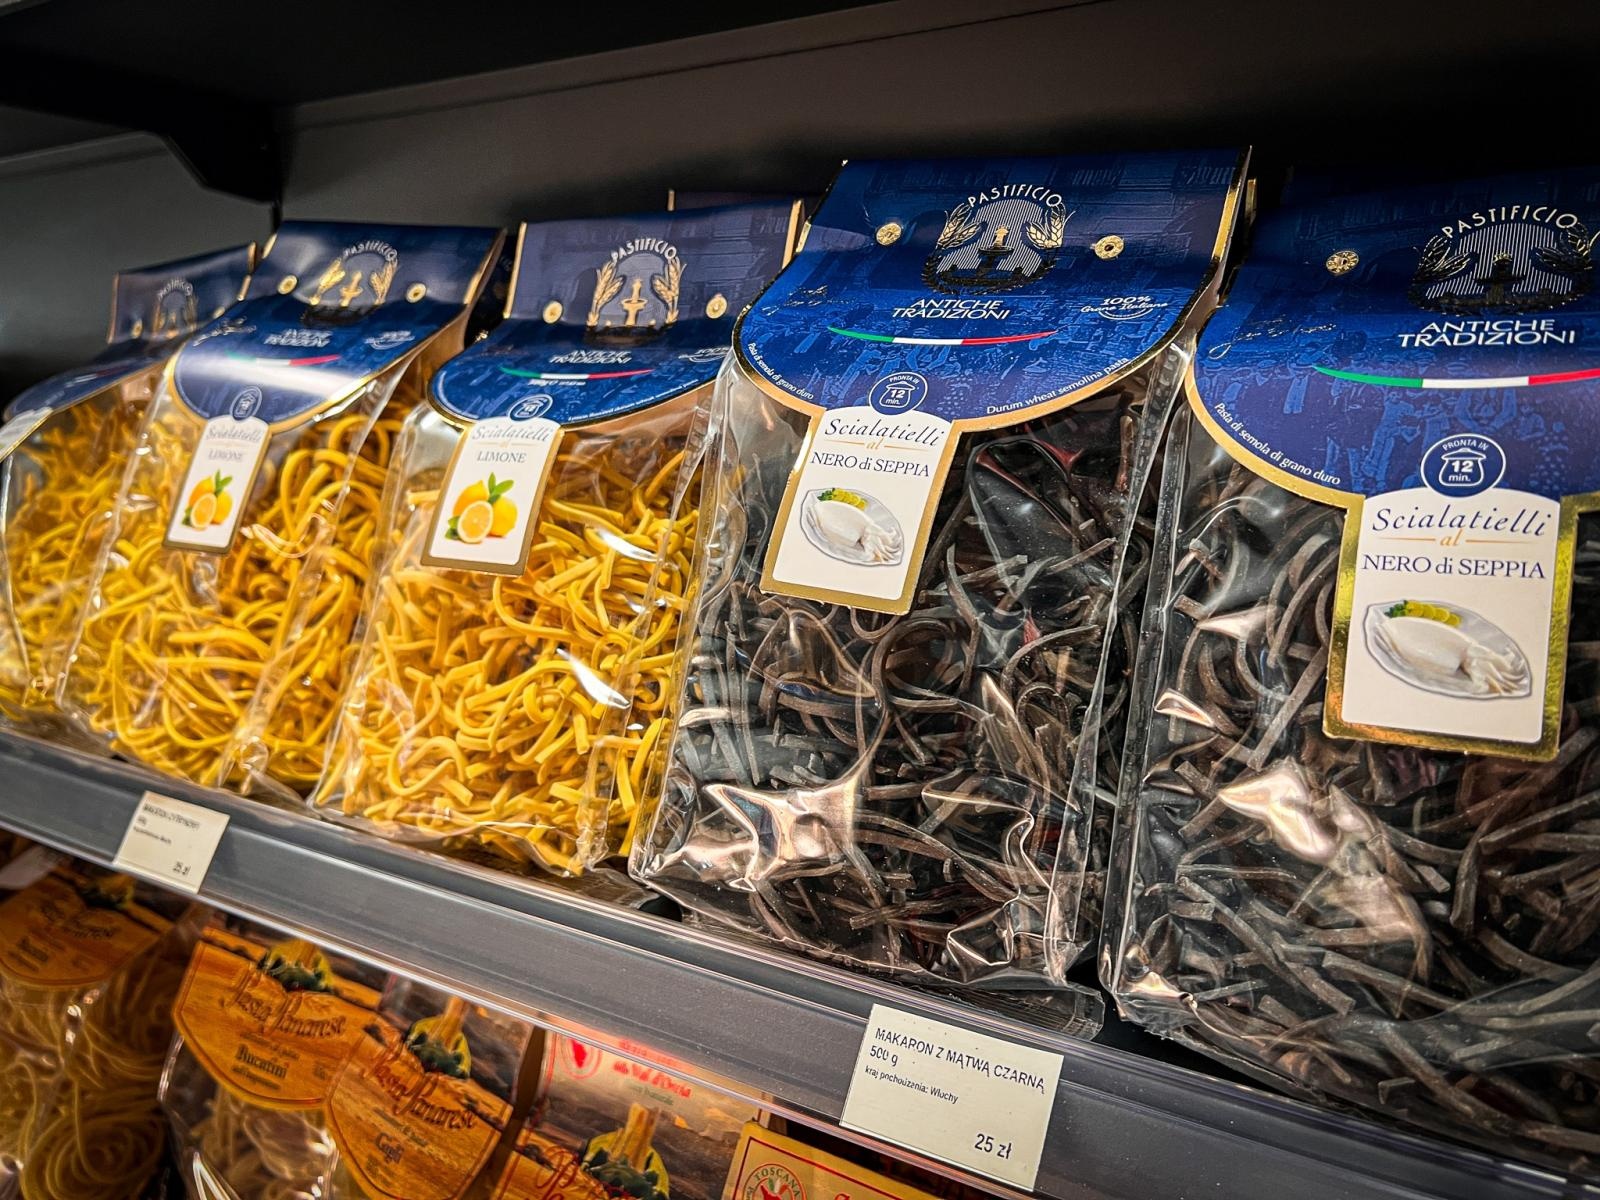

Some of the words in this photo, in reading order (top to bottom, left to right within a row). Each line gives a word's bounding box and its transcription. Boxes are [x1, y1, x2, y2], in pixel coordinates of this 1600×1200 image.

[967, 184, 1063, 208] PASTIFICIO
[1442, 205, 1578, 238] PASTIFICIO
[610, 237, 678, 262] PASTIFICIO
[910, 299, 1004, 310] ANTICHE
[1101, 296, 1151, 305] 100%
[892, 308, 1011, 319] TRADIZIONI
[1421, 319, 1556, 333] ANTICHE
[1398, 330, 1576, 347] TRADIZIONI
[776, 379, 797, 392] grano
[796, 388, 814, 400] duro
[891, 390, 905, 398] 12
[986, 401, 1023, 414] Durum
[1025, 391, 1057, 406] wheat
[1058, 371, 1102, 395] semolina
[1103, 357, 1130, 375] pasta
[472, 424, 552, 442] Scialatielli
[825, 418, 945, 447] Scialatielli
[866, 437, 884, 451] al
[1214, 402, 1233, 424] Pasta
[1230, 421, 1244, 432] di
[1239, 429, 1270, 455] semola
[1270, 450, 1284, 462] di
[1280, 458, 1312, 476] grano
[1313, 469, 1341, 485] duro
[1442, 439, 1476, 451] PRONTA
[1477, 441, 1489, 451] IN
[477, 451, 527, 463] LIMONE
[811, 451, 858, 469] NERO
[858, 457, 873, 471] di
[874, 459, 929, 477] SEPPIA
[1452, 460, 1474, 472] 12
[1448, 473, 1472, 482] min.
[1372, 504, 1552, 537] Scialatielli
[1440, 528, 1464, 547] al
[1363, 554, 1432, 573] NERO
[1435, 557, 1453, 574] di
[1458, 558, 1546, 579] SEPPIA
[870, 1045, 889, 1061] 500
[891, 1054, 899, 1067] g
[875, 1027, 934, 1056] MAKARON
[936, 1046, 945, 1059] Z
[946, 1049, 990, 1077] MĄTWĄ
[994, 1064, 1045, 1094] CZARNĄ
[865, 1065, 879, 1079] kraj
[974, 1133, 995, 1153] 25
[996, 1142, 1012, 1160] zł
[753, 1166, 801, 1197] TOSCANA
